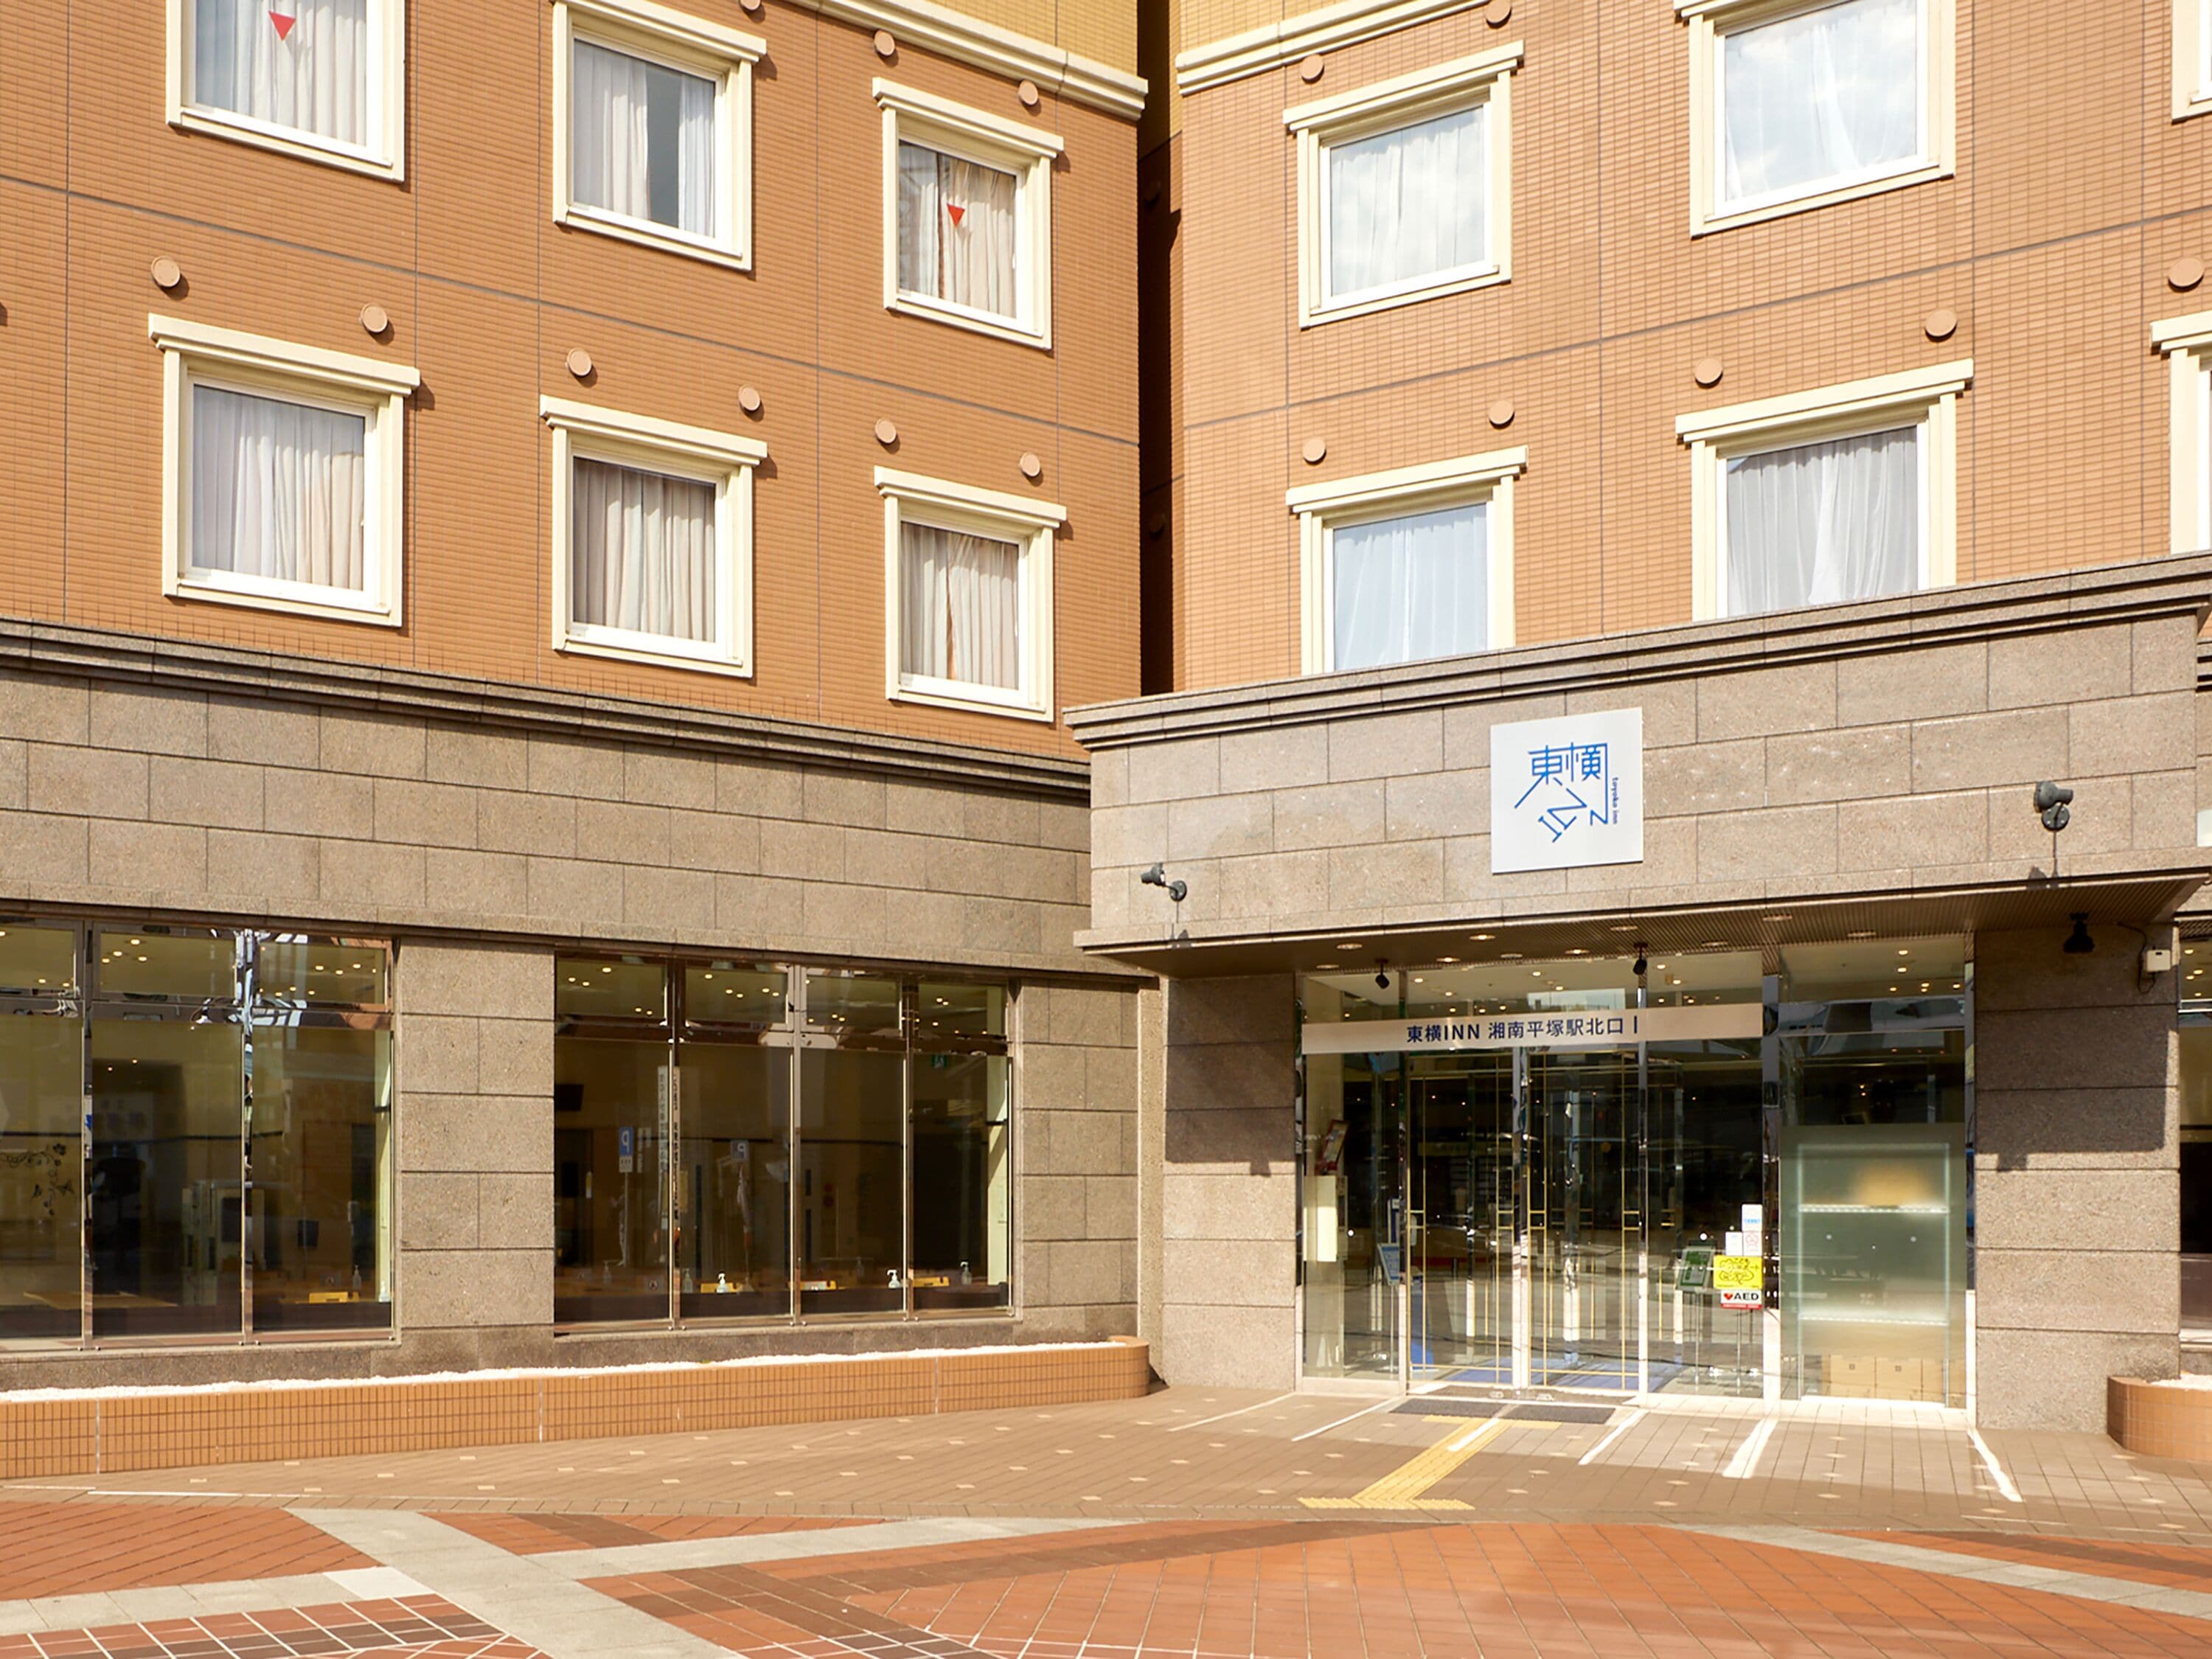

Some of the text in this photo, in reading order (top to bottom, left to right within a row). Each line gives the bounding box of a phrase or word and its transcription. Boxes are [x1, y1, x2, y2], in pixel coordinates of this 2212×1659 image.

[1407, 1023, 1481, 1043] 東横INN
[1488, 1018, 1624, 1039] 湘南平塚駅北口
[1733, 1292, 1759, 1301] AED
